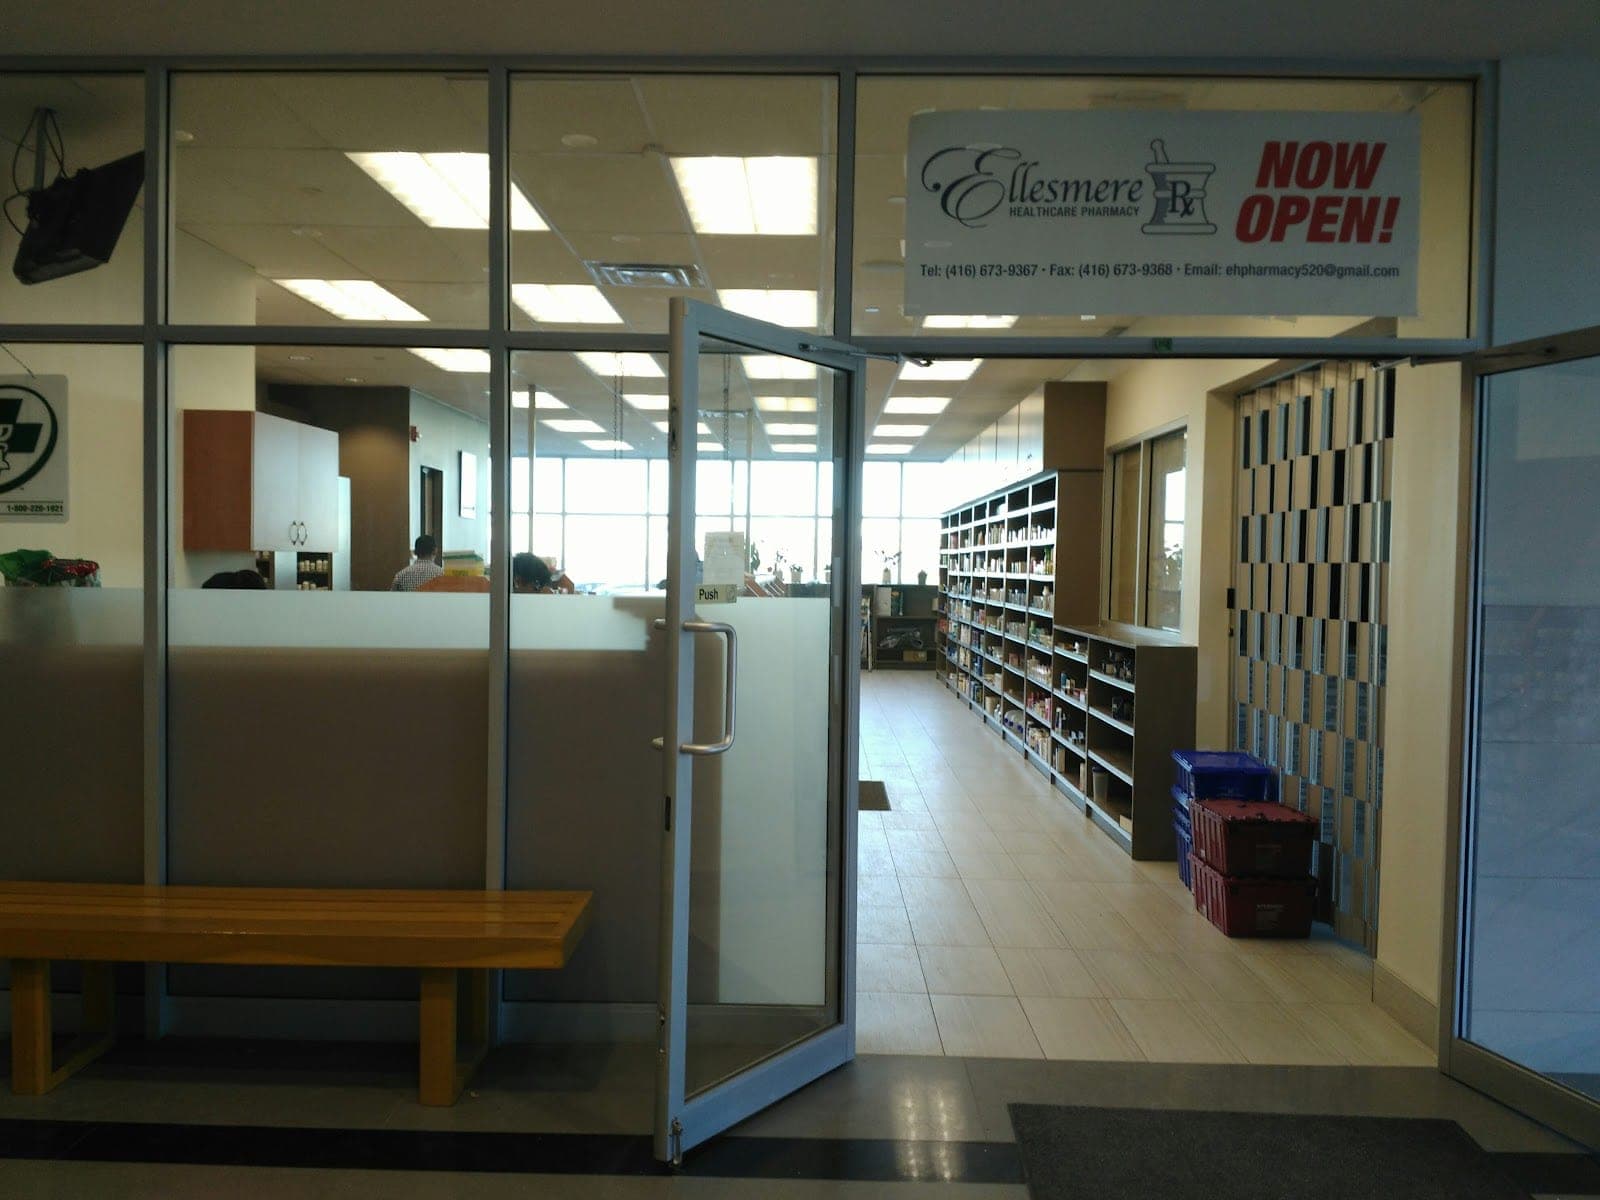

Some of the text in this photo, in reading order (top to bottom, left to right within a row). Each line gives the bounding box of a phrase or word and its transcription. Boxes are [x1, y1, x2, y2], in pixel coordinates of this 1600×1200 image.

[1256, 141, 1387, 189] NOW
[921, 147, 1143, 228] Ellesmere
[1009, 206, 1140, 217] HEALTHCARE PHARMACY
[1235, 196, 1400, 243] OPEN!
[920, 264, 1399, 279] Tel: (416) 673-9367 Fax: (416) 673-9368 Email: ehpharmacy520@gmail.com
[699, 588, 719, 600] Push
